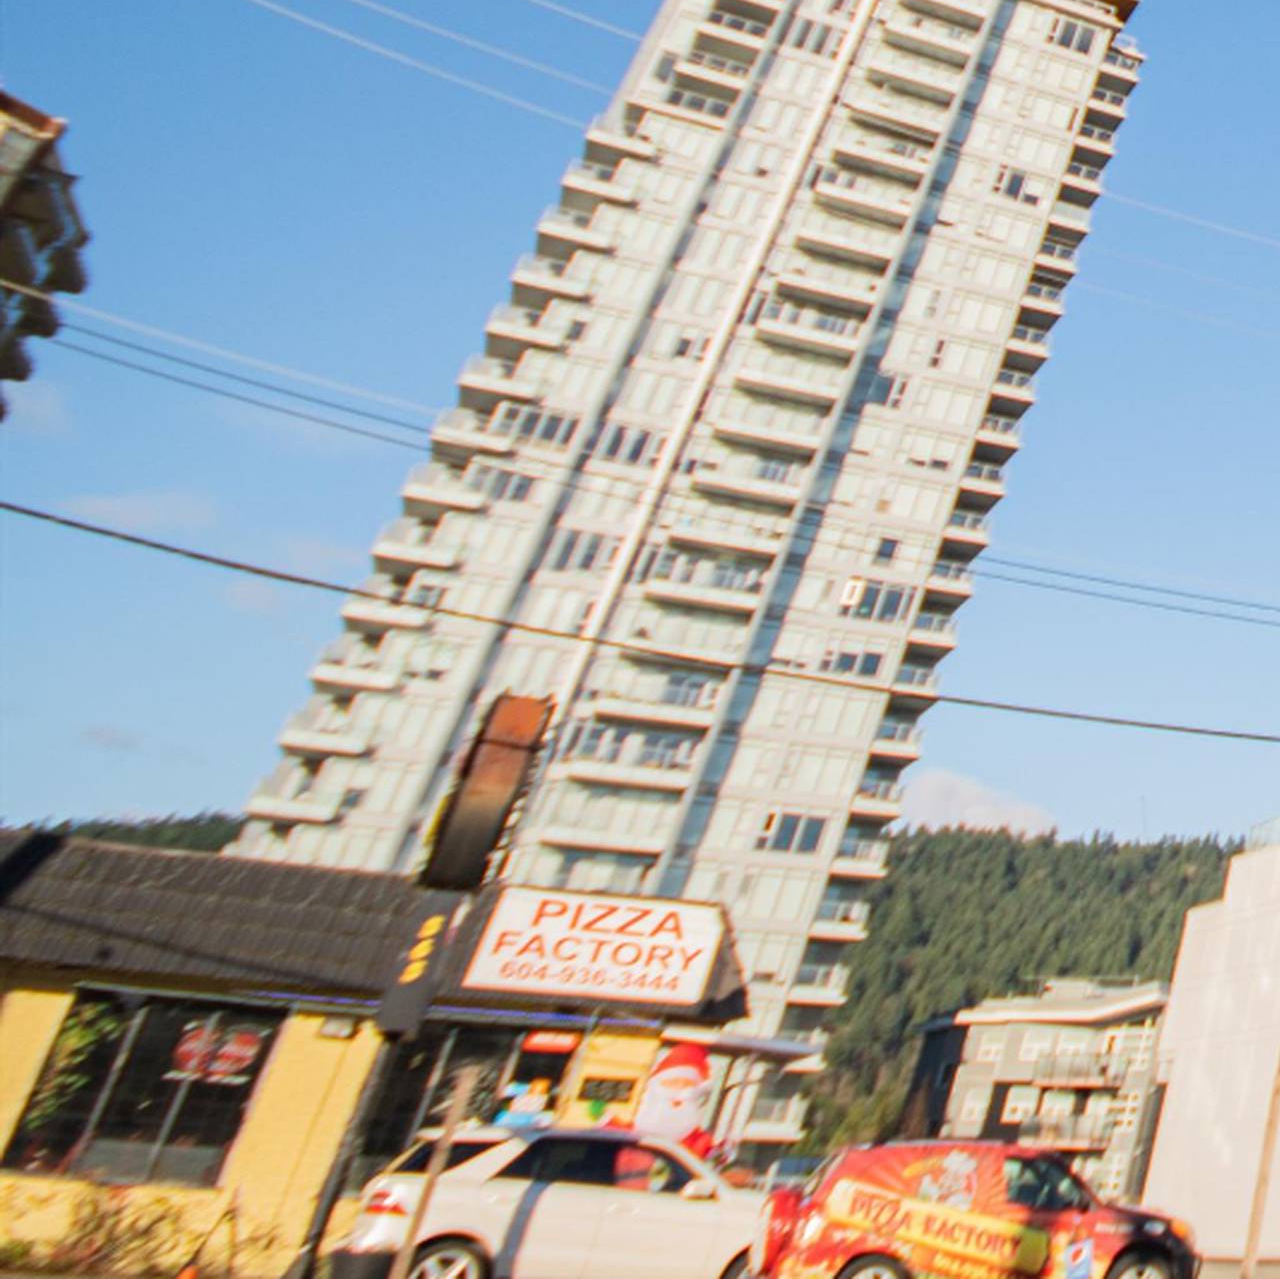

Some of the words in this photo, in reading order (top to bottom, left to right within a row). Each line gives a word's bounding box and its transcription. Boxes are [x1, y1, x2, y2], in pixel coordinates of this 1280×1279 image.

[531, 899, 684, 939] PIZZA
[491, 931, 704, 971] FACTORY
[499, 960, 681, 991] 604-936-3444
[849, 1190, 913, 1233] PIZZA
[922, 1212, 1023, 1259] FACTORY
